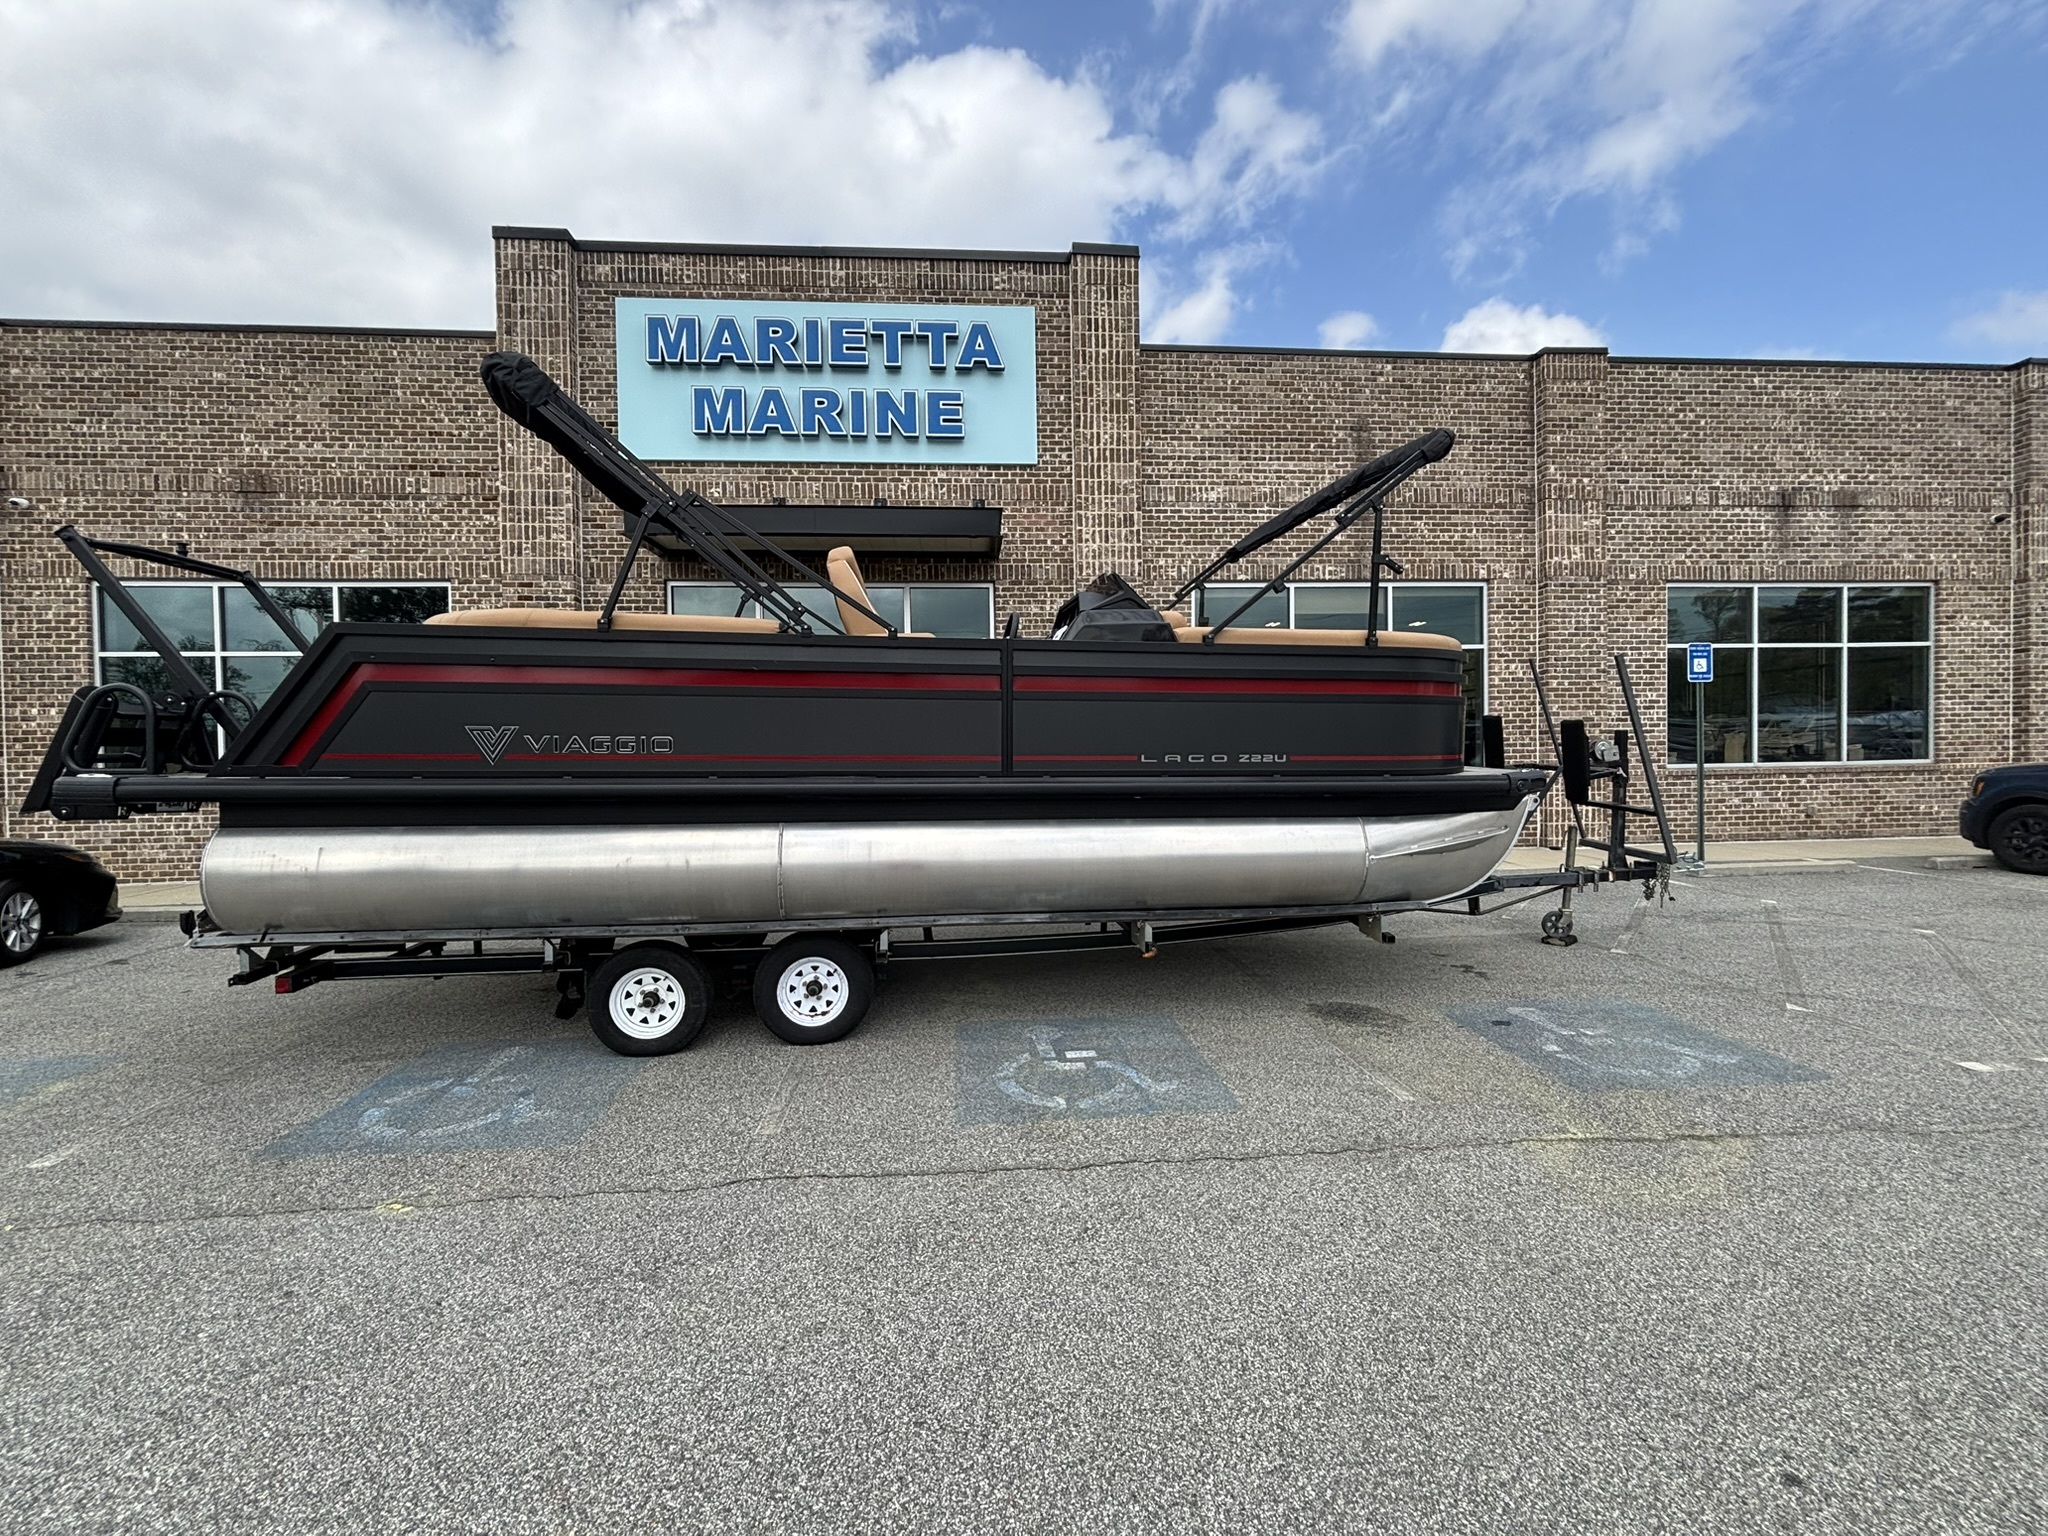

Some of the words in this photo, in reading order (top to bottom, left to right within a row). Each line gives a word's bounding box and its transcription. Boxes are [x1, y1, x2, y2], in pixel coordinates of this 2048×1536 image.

[645, 314, 1005, 371] MARIETTA
[690, 385, 965, 440] MARINE
[523, 735, 674, 754] VIAGGIO
[1140, 754, 1228, 763] LAGO
[1238, 754, 1287, 763] Z22U
